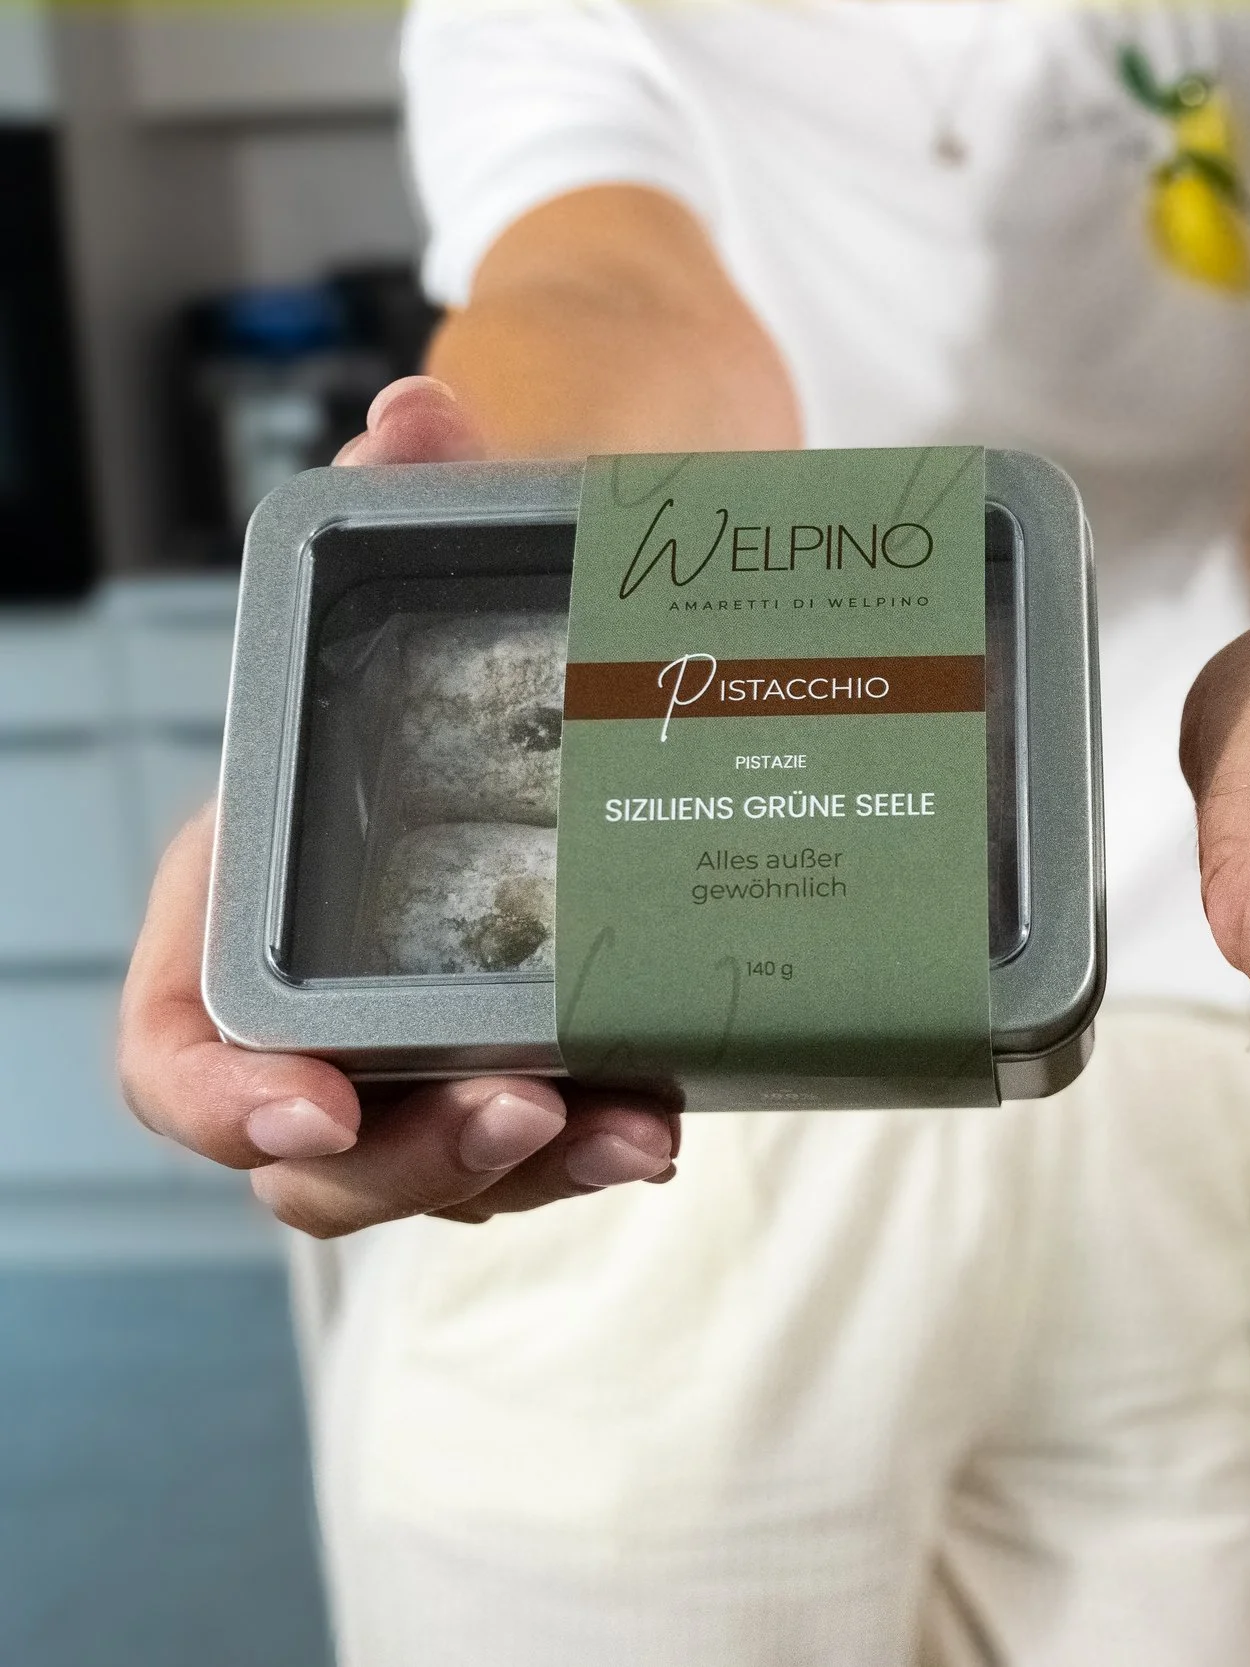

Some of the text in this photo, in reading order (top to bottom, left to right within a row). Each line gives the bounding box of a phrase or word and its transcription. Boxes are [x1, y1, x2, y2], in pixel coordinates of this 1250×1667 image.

[619, 499, 934, 600] WELPINO
[669, 596, 930, 611] AMARETTI DI WELPINO
[657, 653, 890, 742] PISTACCHIO
[735, 754, 807, 769] PISTAZIE
[605, 791, 935, 822] SIZILIENS GRÜNE SEELE
[696, 848, 843, 870] Alles außer
[691, 876, 847, 904] gewöhnlich
[746, 961, 793, 979] 140 g
